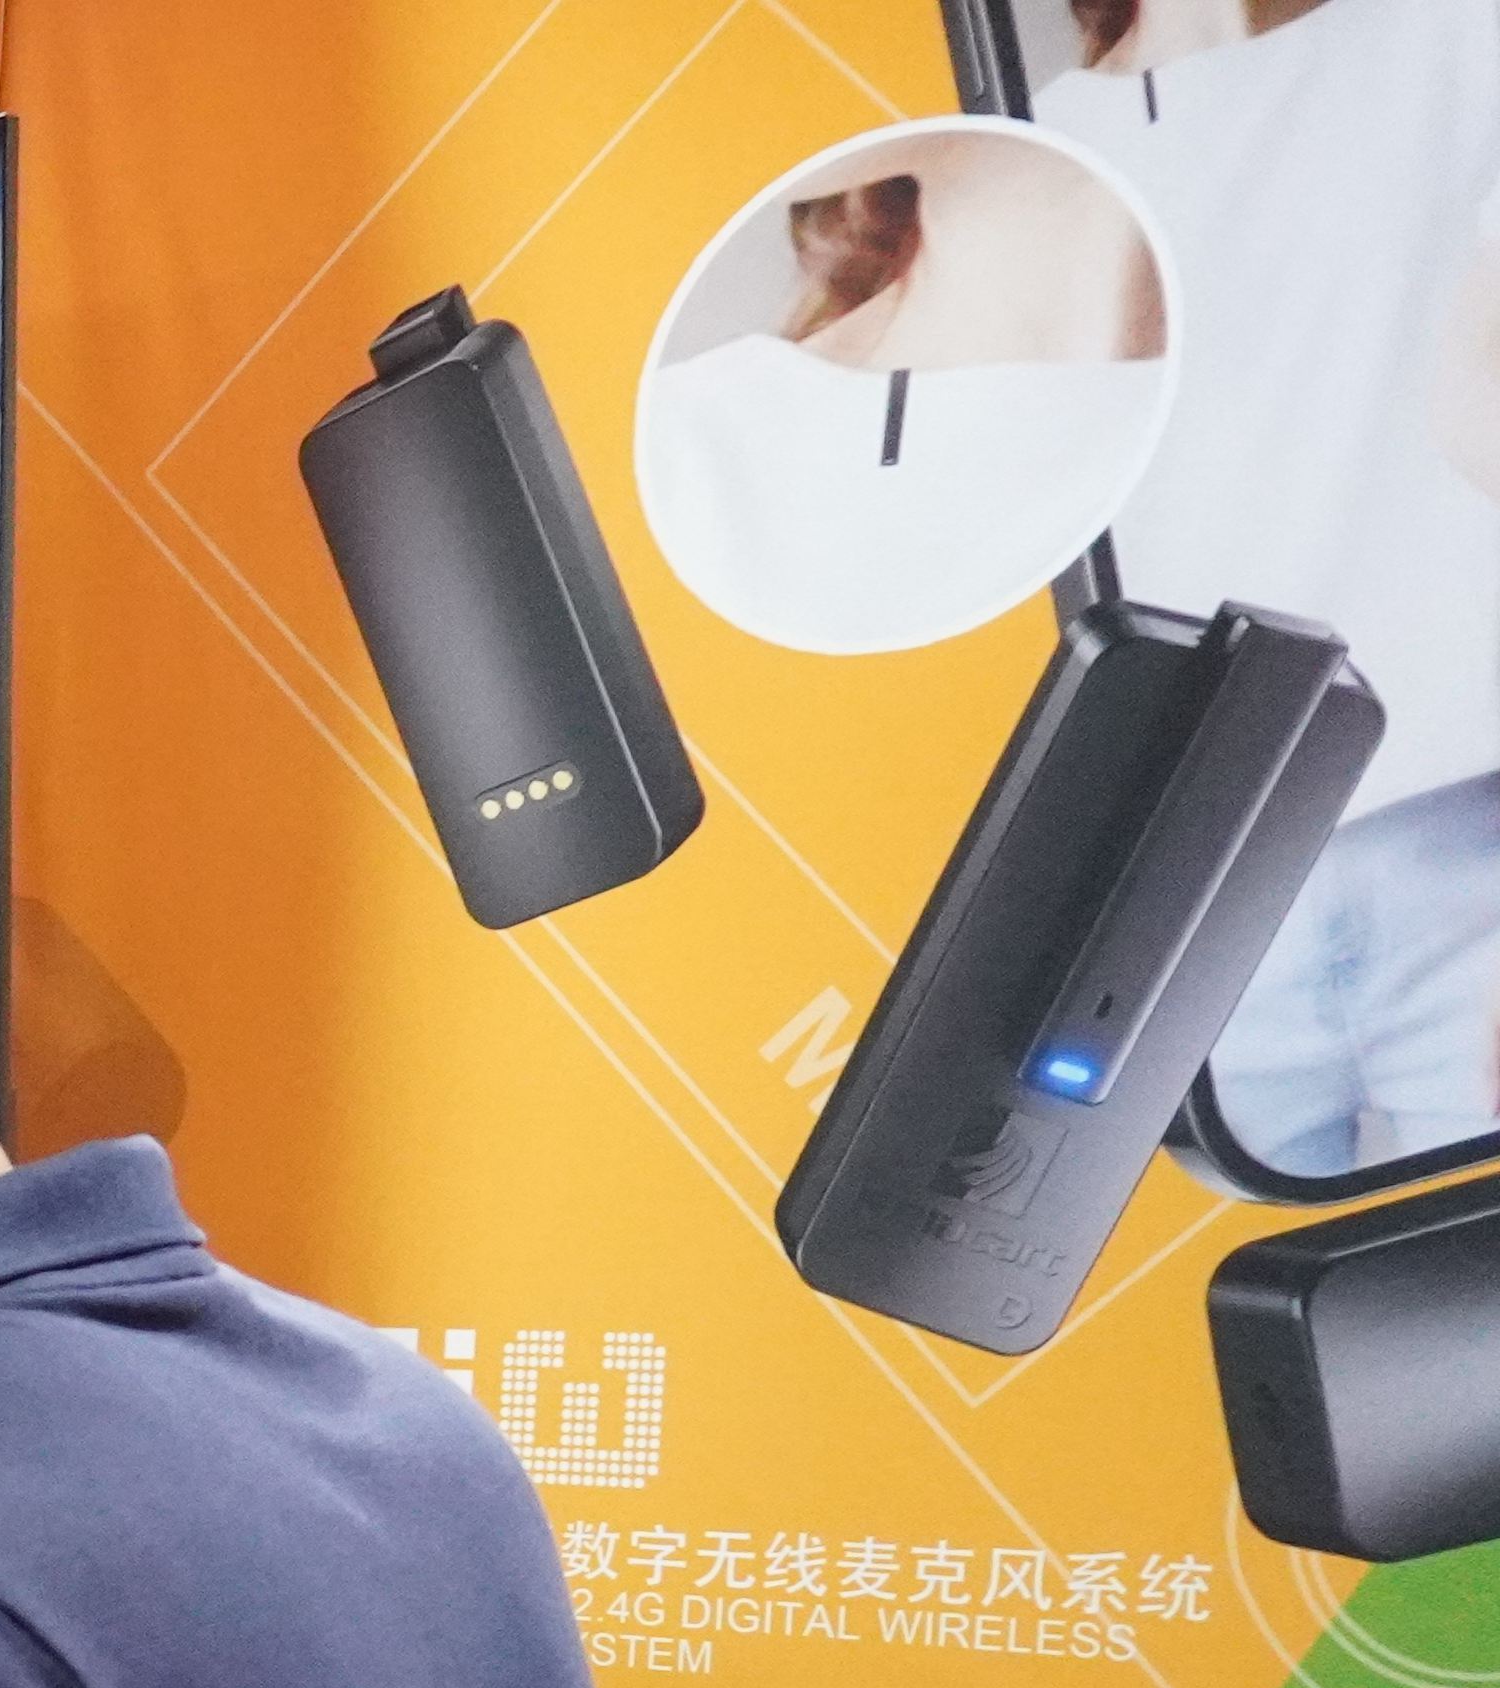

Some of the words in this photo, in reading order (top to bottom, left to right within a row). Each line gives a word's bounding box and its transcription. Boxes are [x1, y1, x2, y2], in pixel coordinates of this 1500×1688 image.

[560, 1520, 1213, 1623] 数字无线麦克风系统
[681, 1594, 861, 1641] DIGITAL
[876, 1607, 1138, 1663] WIRELESS
